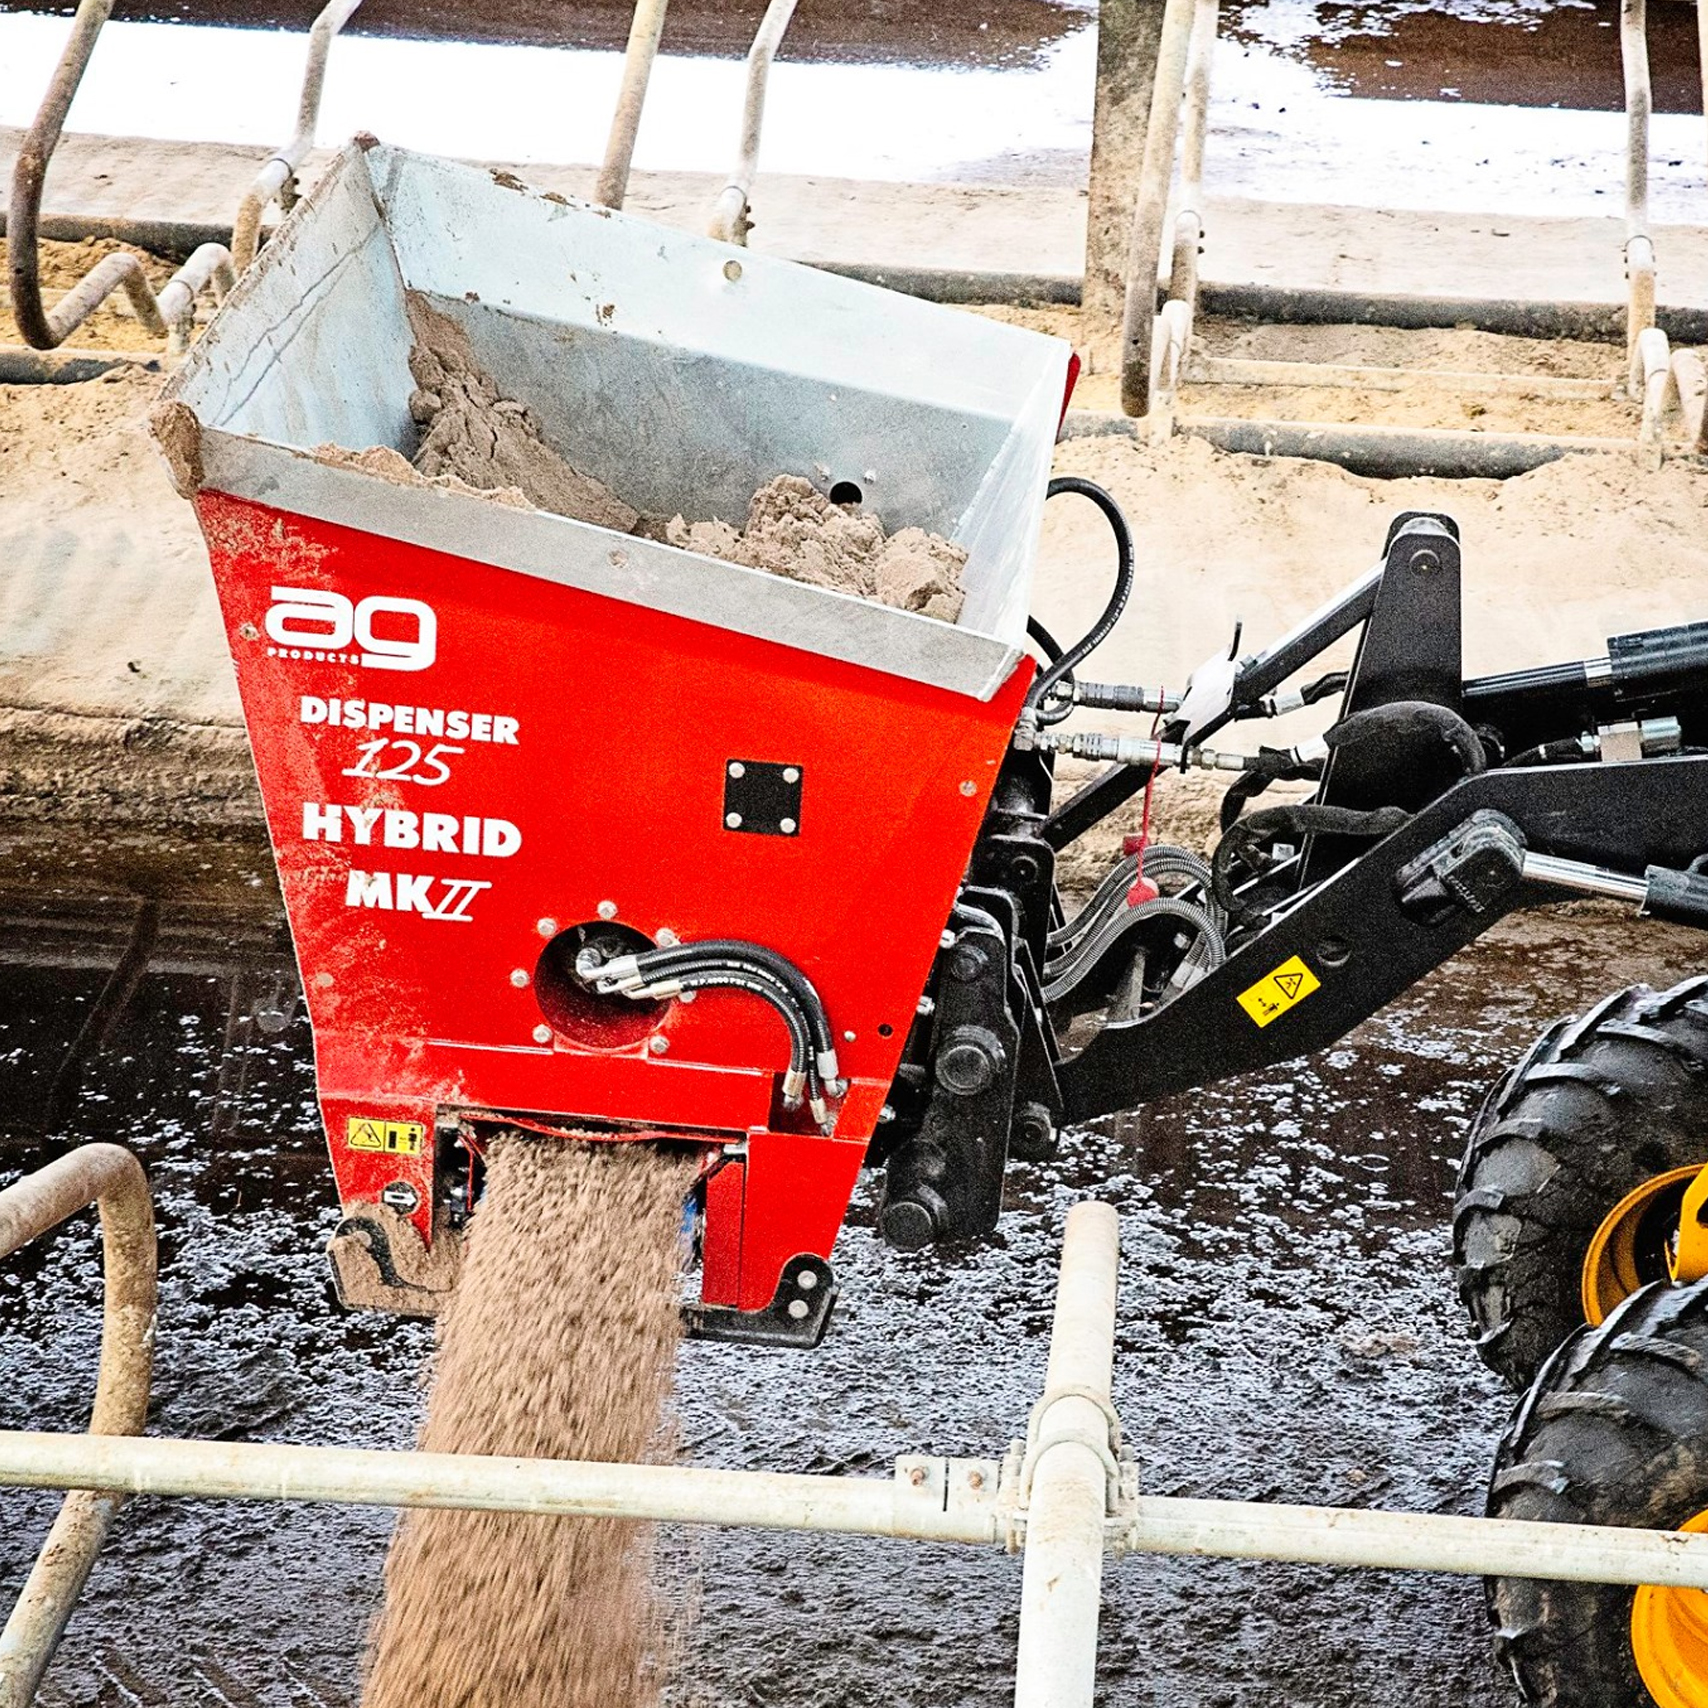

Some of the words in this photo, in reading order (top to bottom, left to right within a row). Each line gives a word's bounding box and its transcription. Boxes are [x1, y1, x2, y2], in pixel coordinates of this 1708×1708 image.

[264, 585, 437, 672] ag
[266, 646, 360, 666] PRODUCTS
[300, 695, 520, 745] DISPENSER
[341, 737, 465, 787] 125
[302, 802, 523, 858] HYBRID
